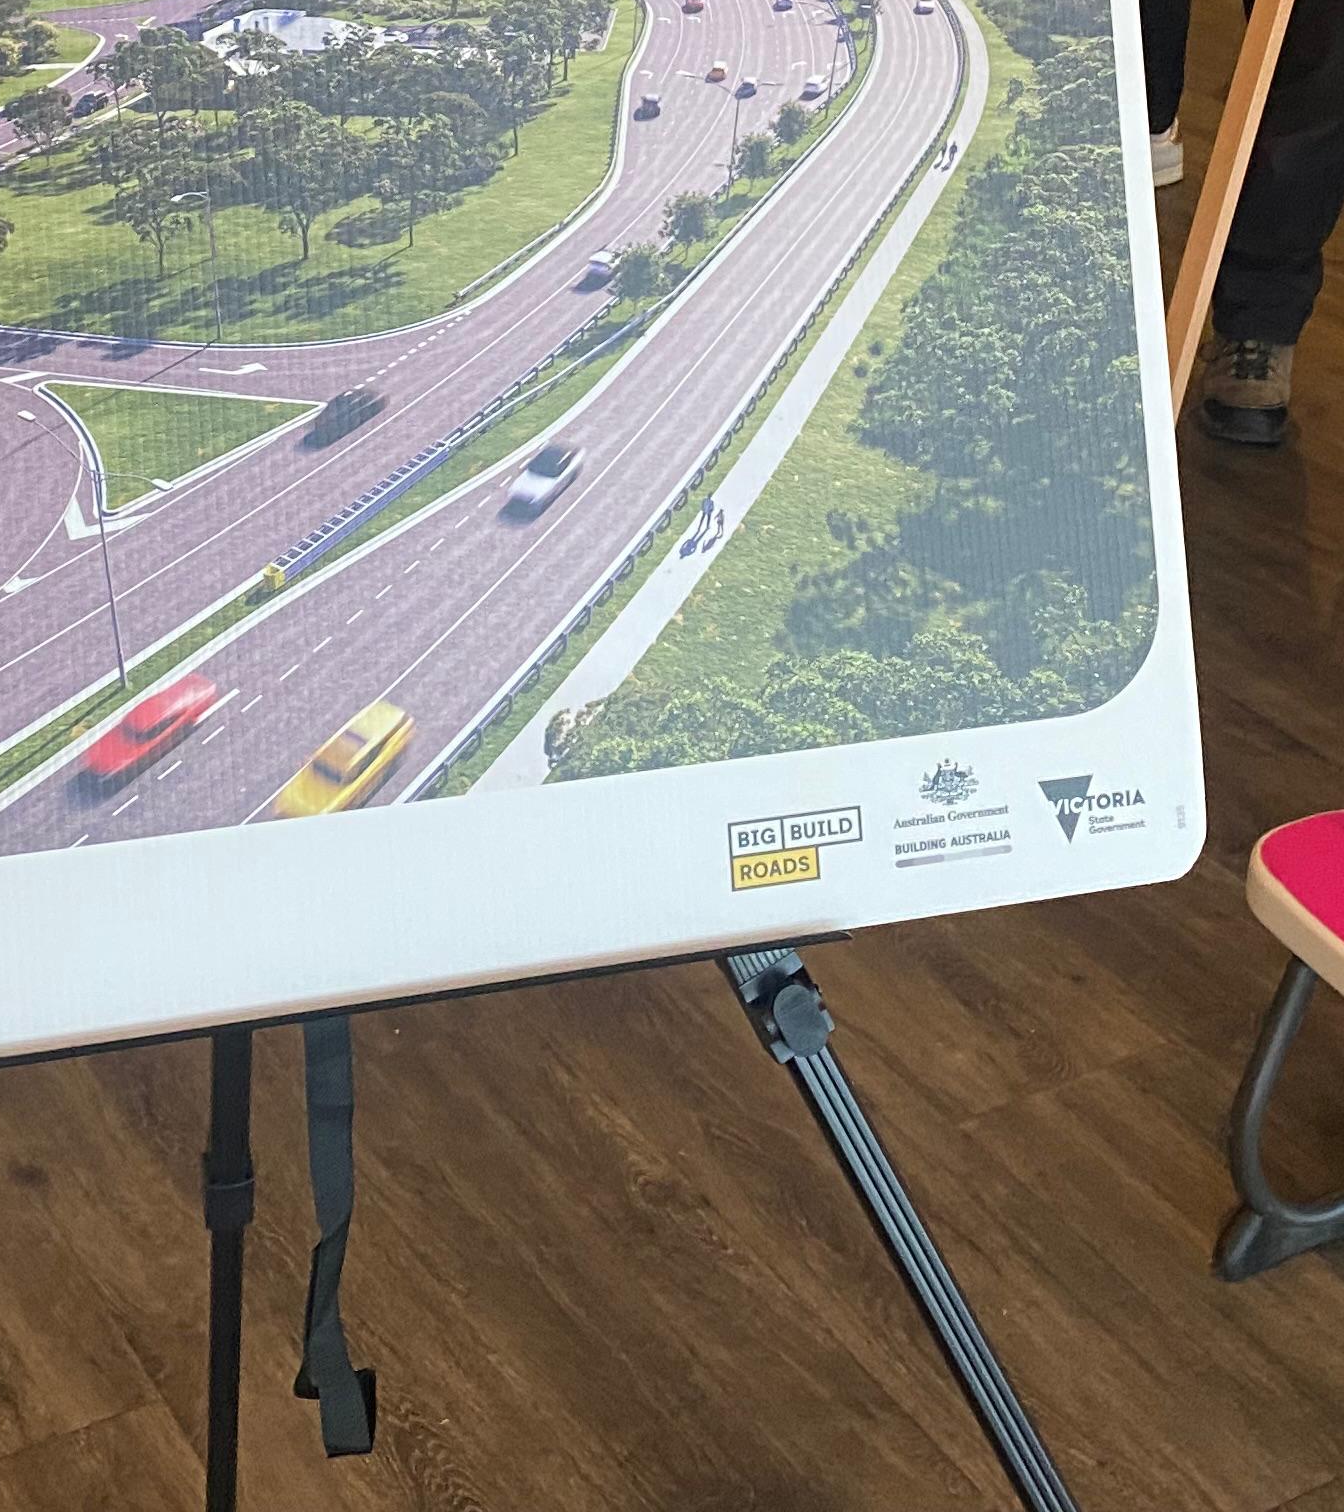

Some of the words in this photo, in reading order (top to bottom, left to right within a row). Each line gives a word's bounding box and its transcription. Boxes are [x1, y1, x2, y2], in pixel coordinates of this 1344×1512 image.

[1048, 788, 1146, 816] VICTORIA
[893, 813, 946, 829] Australian
[947, 805, 1009, 822] Government
[1088, 815, 1114, 826] State
[1088, 820, 1146, 835] Government
[738, 828, 776, 848] BIG
[790, 817, 853, 841] BUILD
[895, 838, 947, 856] BUILDING
[950, 829, 1012, 848] AUSTRALIA
[739, 855, 811, 882] ROADS
